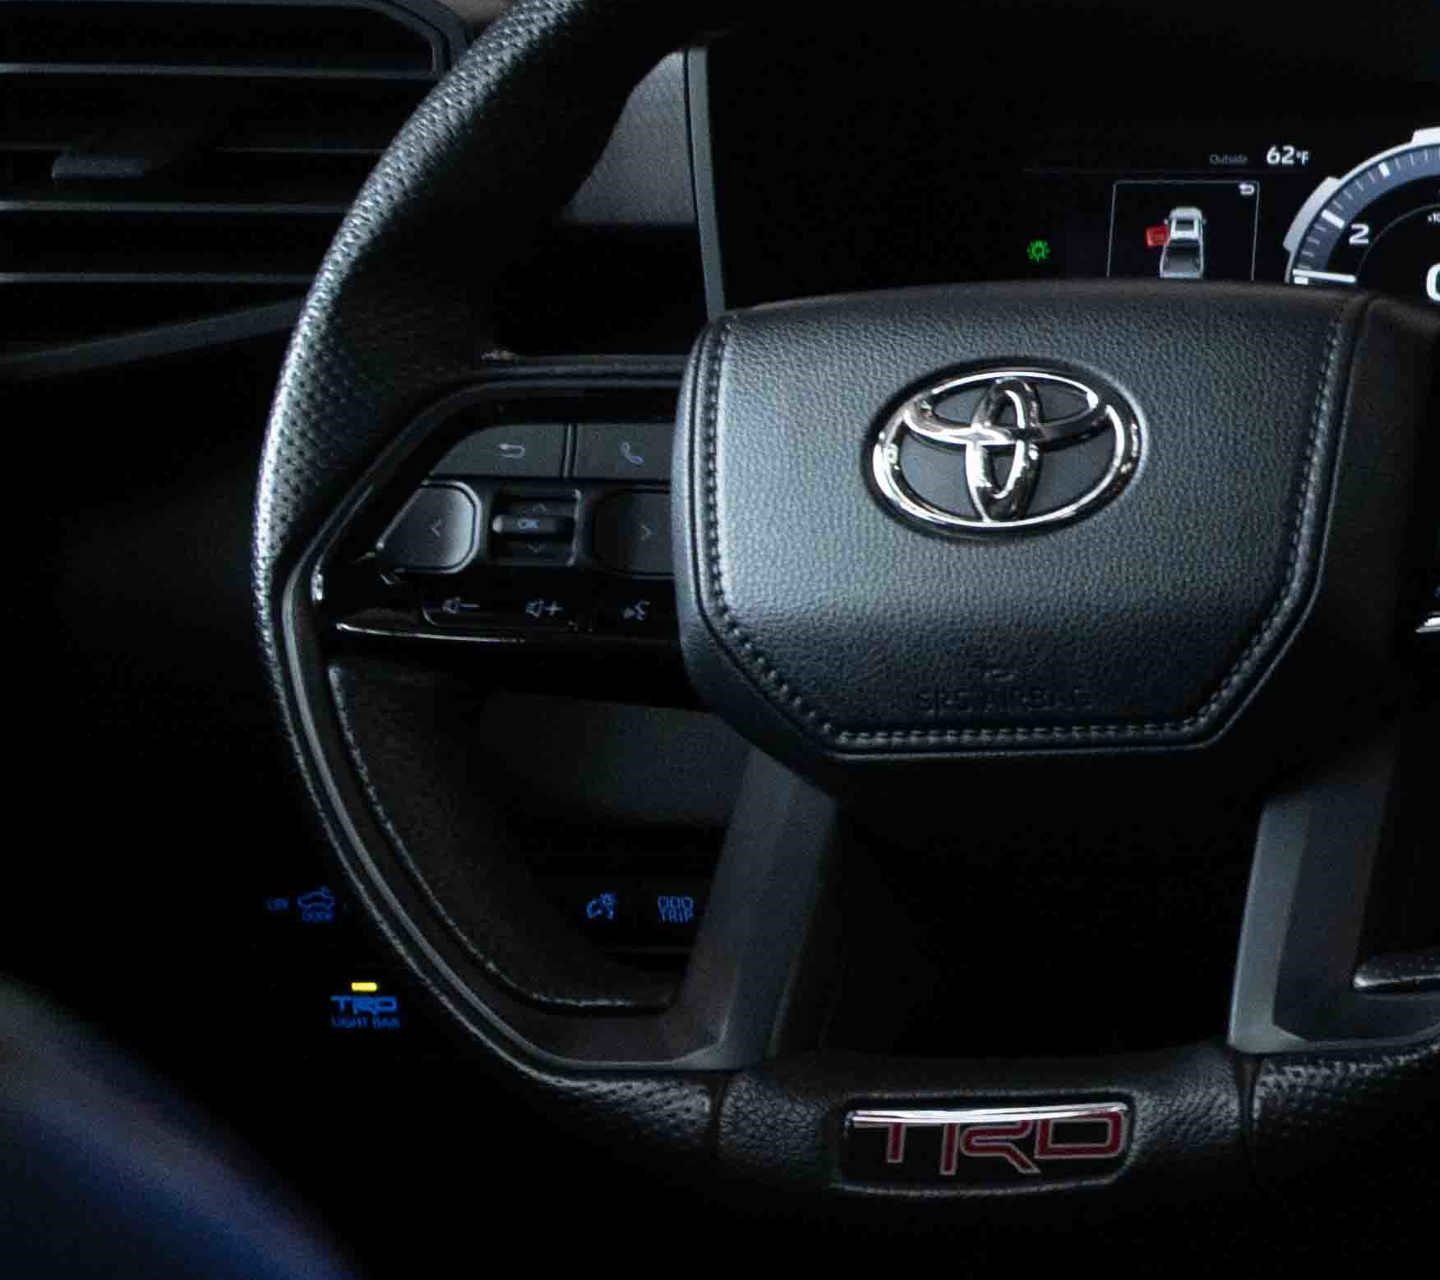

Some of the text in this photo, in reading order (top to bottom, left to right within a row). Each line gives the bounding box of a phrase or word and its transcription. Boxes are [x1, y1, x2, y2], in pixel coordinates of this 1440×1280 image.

[1348, 223, 1371, 246] 2
[329, 994, 399, 1015] TRD
[850, 1108, 1126, 1177] TRD
